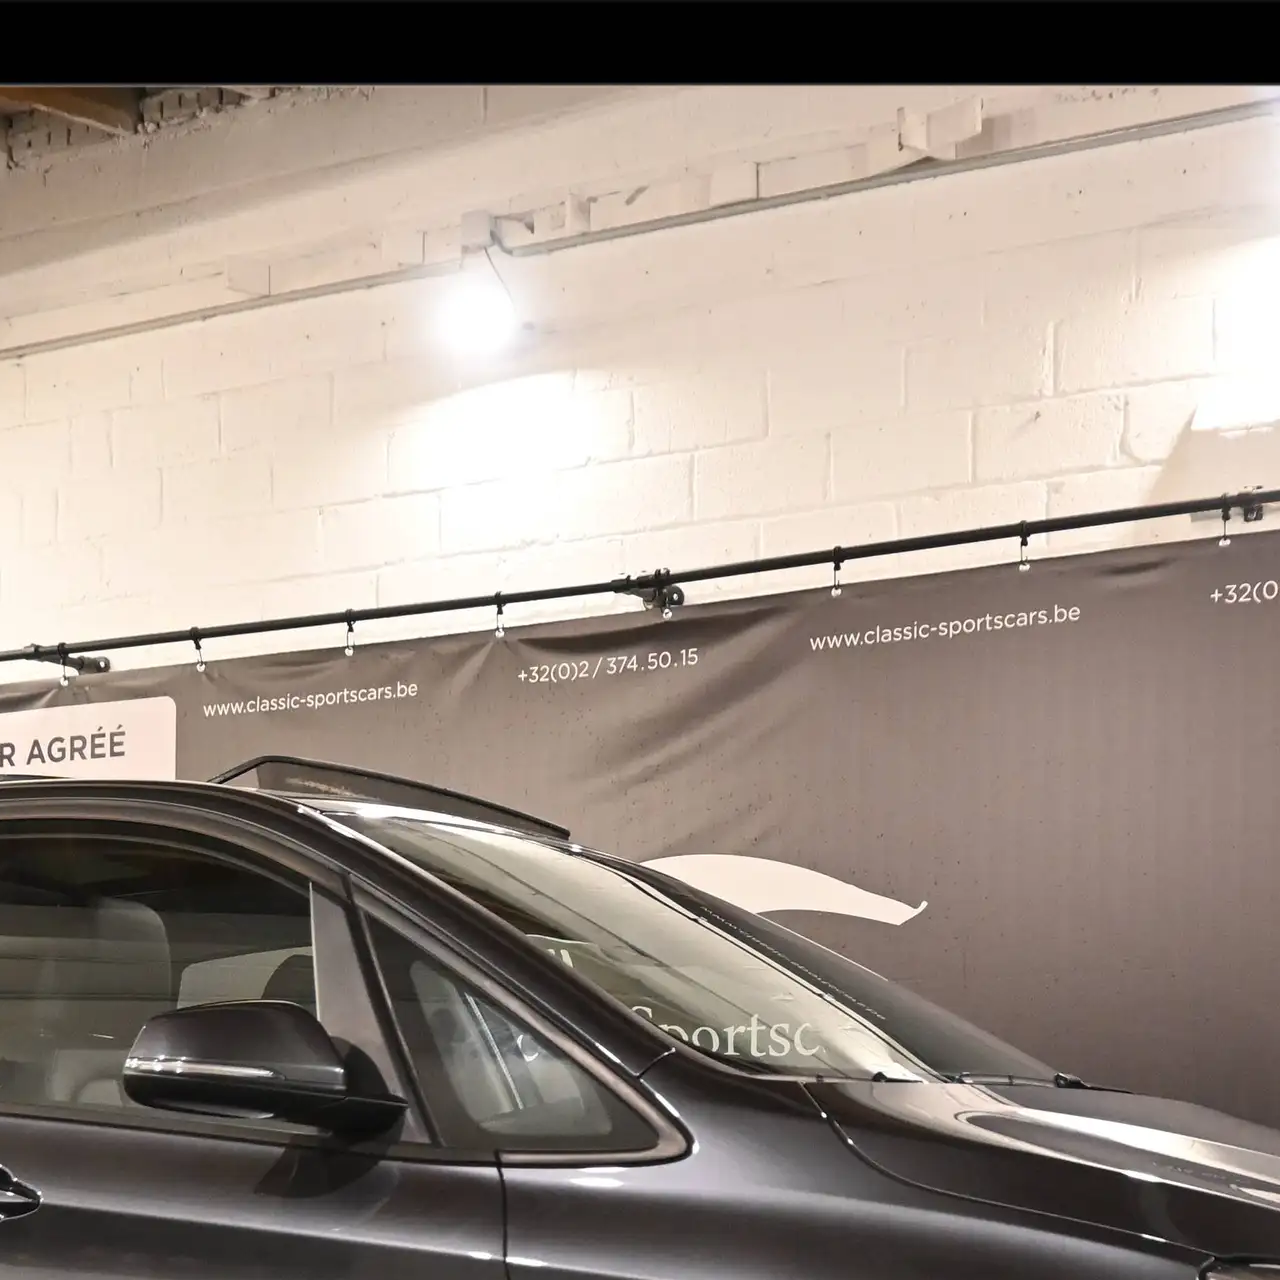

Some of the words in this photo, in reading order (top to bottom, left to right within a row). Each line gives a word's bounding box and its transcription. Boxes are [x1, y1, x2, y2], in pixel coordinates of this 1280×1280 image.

[809, 604, 1081, 651] www.classic-sportscars.be
[517, 660, 590, 684] +32(0)2
[606, 647, 699, 675] 374.50.15
[203, 680, 418, 717] www.classic-sportscars.be
[26, 724, 126, 766] AGRÉÉ
